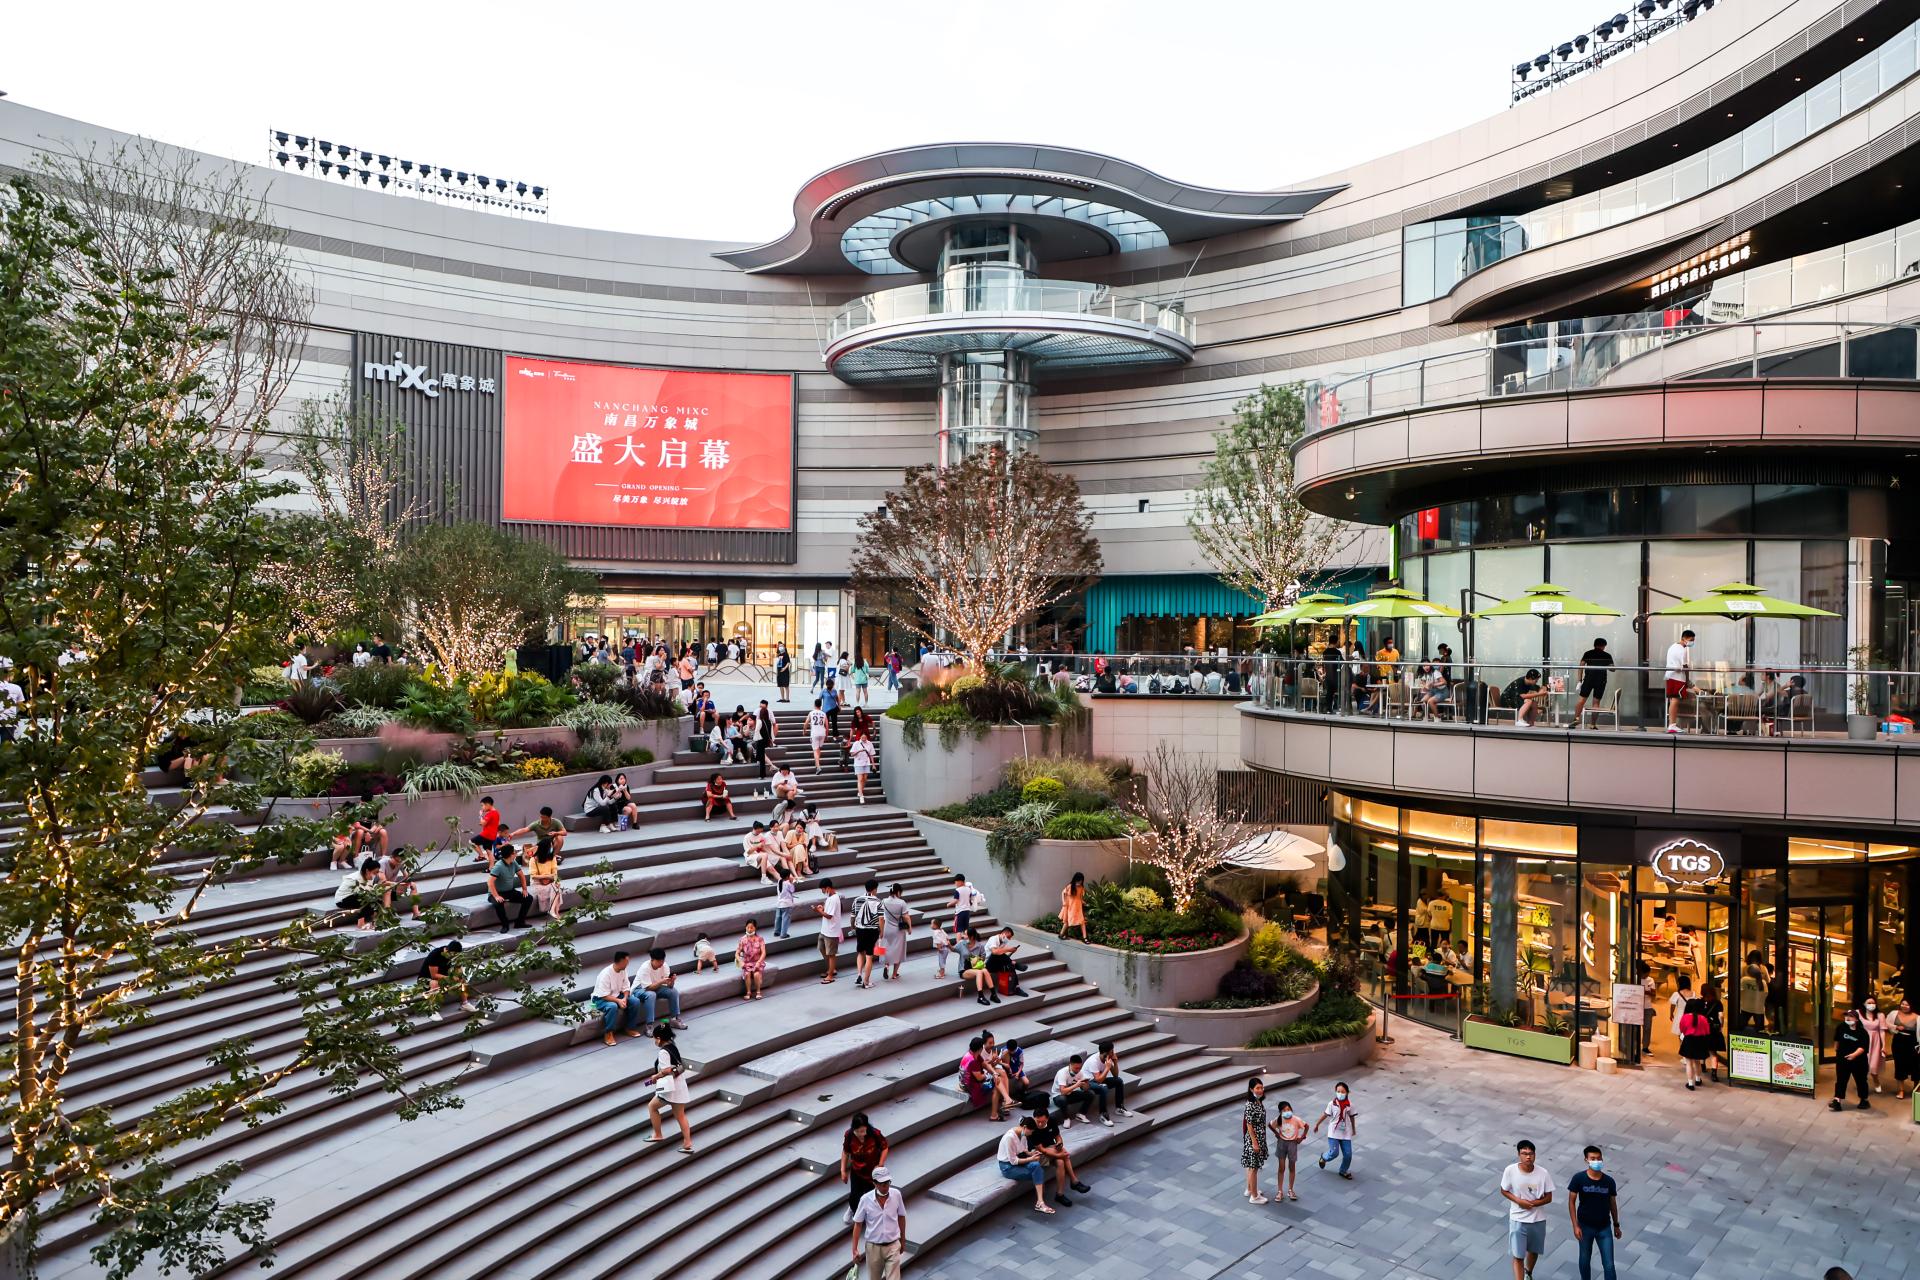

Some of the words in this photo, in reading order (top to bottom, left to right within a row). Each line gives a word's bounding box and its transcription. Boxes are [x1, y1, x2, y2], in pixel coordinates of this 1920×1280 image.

[1650, 245, 1751, 299] 西西弗书店&矢量咖啡
[441, 373, 496, 394] 萬象城
[593, 401, 669, 414] NANCHANG
[676, 406, 709, 416] MIXC
[604, 413, 699, 431] 南昌万象城
[570, 432, 731, 470] 盛大启幕
[1667, 855, 1711, 872] TGS
[1507, 1037, 1527, 1047] TGS
